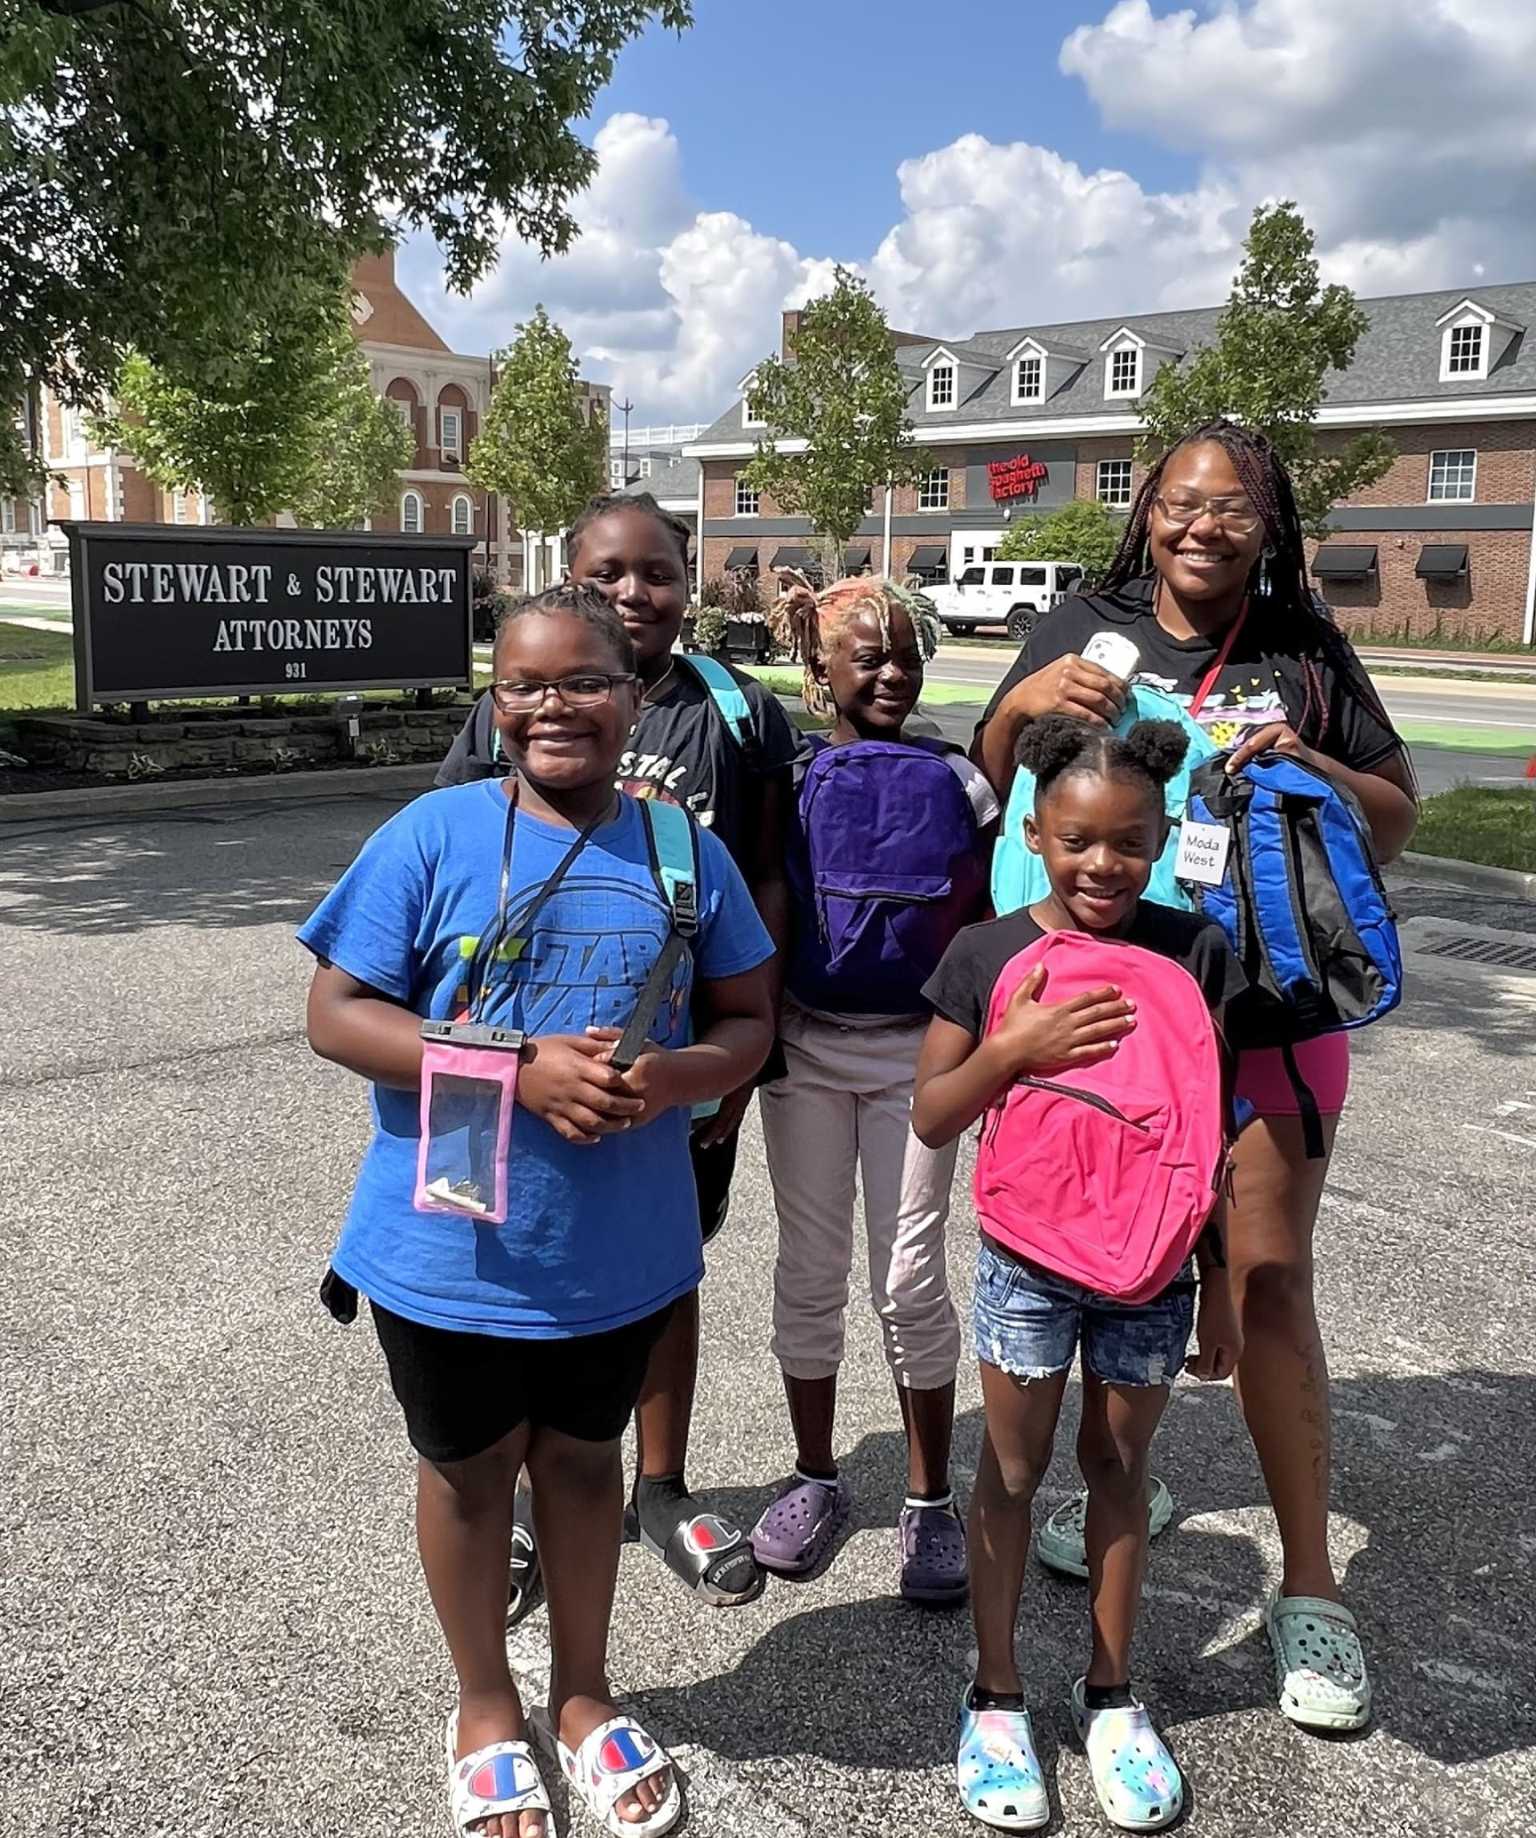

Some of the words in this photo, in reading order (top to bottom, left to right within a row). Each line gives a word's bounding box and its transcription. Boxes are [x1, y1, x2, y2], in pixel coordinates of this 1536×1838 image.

[1007, 454, 1030, 470] old
[103, 562, 271, 604] STEWART
[286, 572, 302, 597] &
[315, 566, 457, 604] STEWART
[212, 619, 373, 652] ATTORNEYS
[285, 663, 307, 679] 931
[1186, 834, 1220, 851] Moda
[1183, 850, 1216, 867] West
